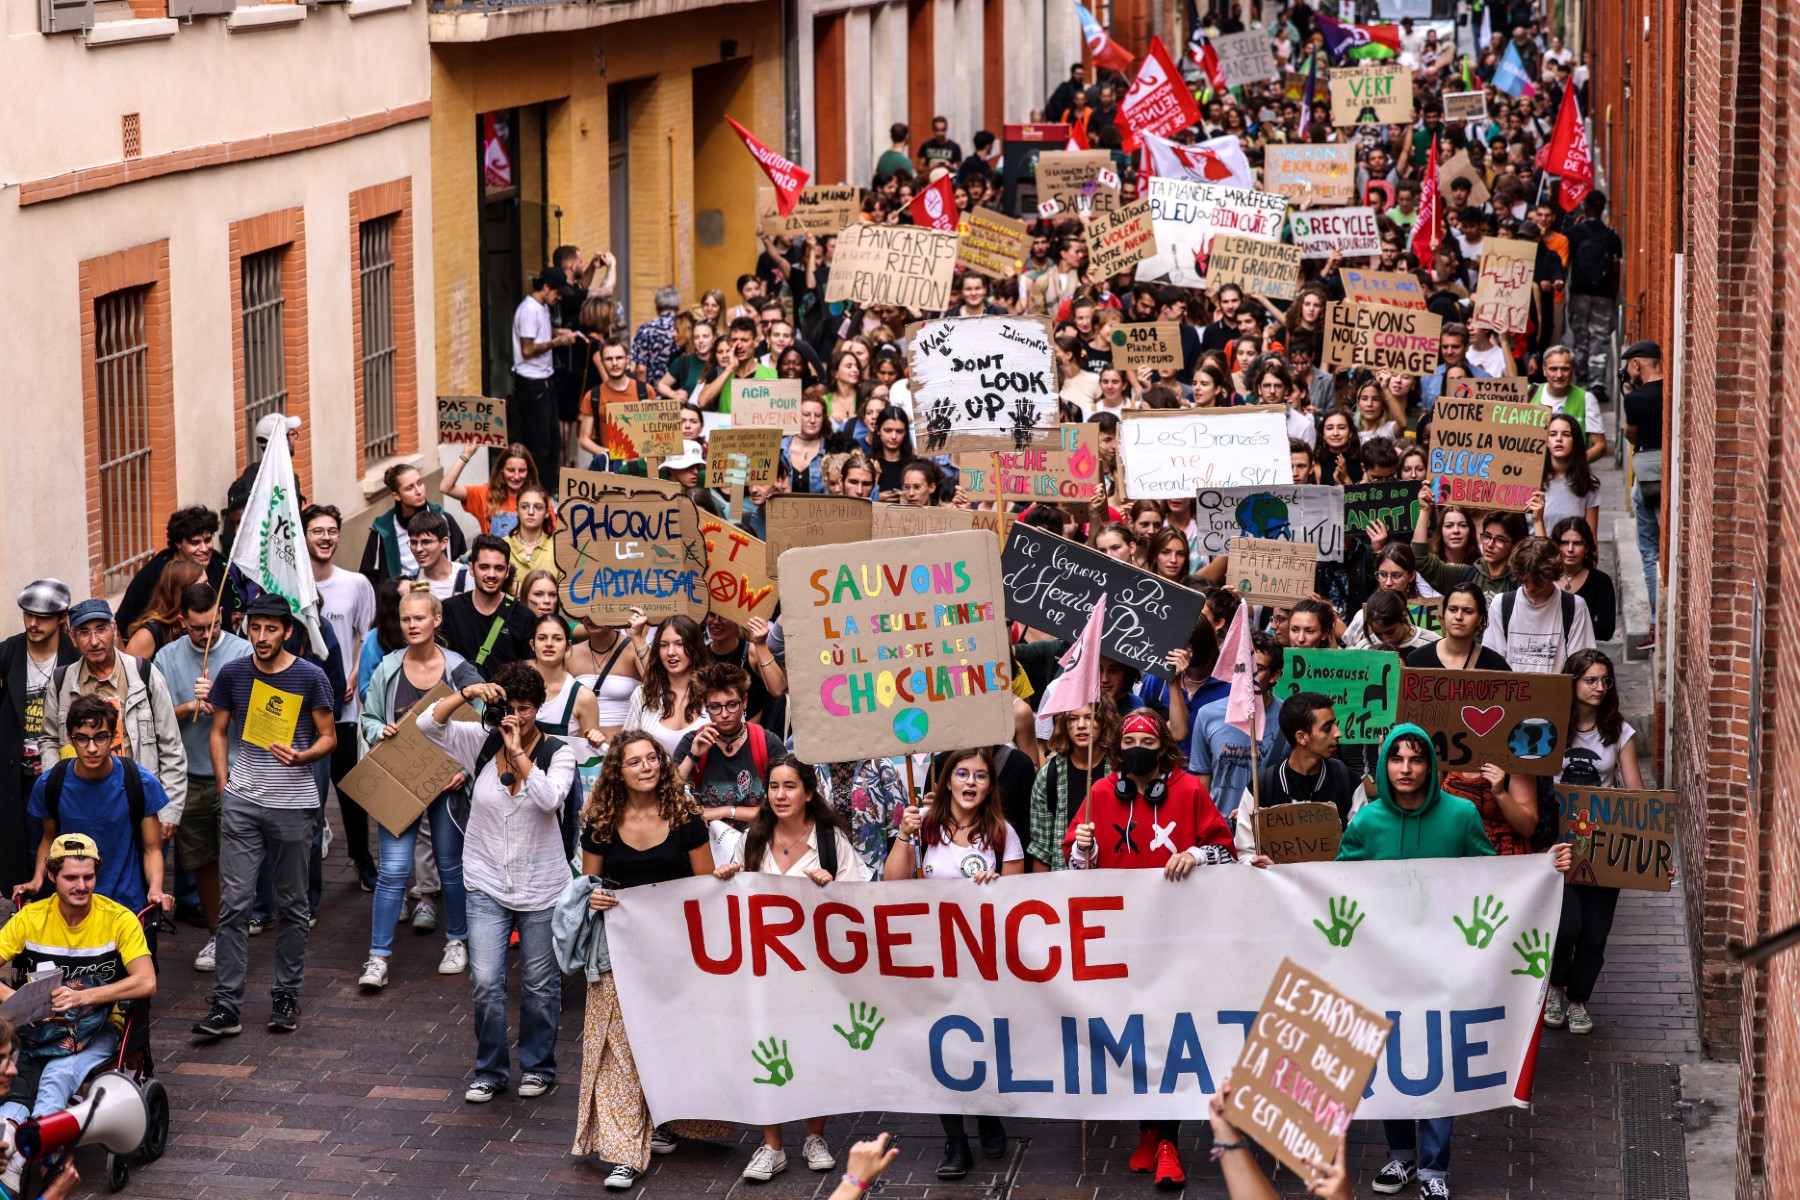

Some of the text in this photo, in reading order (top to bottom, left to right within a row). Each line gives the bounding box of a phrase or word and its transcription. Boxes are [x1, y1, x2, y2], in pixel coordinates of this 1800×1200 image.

[1349, 76, 1395, 98] VERT
[1150, 181, 1166, 196] TA
[1150, 198, 1197, 224] BLEU
[1211, 208, 1239, 229] BIEN
[1310, 215, 1376, 236] RECYCLE
[857, 225, 955, 259] PANCARTES
[1088, 222, 1107, 239] LES
[1091, 229, 1154, 268] NOTRE AVENIR
[1224, 237, 1300, 264] L'ENFUMAGE
[885, 252, 937, 276] RIEN
[1211, 253, 1301, 281] NUIT GRAVEMENT
[1332, 304, 1416, 333] ÉLEVONS
[1126, 341, 1167, 353] Planet B
[1129, 327, 1158, 342] 404
[1331, 328, 1440, 353] NOUS CONTRE
[951, 353, 1004, 372] DONT
[1127, 354, 1174, 364] NOT FOUND
[980, 371, 1048, 395] LOOK
[1476, 381, 1518, 393] TOTAL
[438, 400, 494, 415] PAS DE
[623, 401, 679, 413] NOUS SOMMES LES
[769, 398, 797, 410] POUR
[964, 393, 1005, 422] UP
[1437, 401, 1484, 422] VOTRE
[439, 420, 490, 432] PAS DE
[440, 412, 490, 423] CLIMAT
[1060, 427, 1079, 451] TE
[1134, 422, 1271, 449] Les Bronzés
[1436, 430, 1546, 455] VOUS LA VOULEZ
[711, 459, 729, 470] RES
[1171, 454, 1201, 469] ne
[1431, 447, 1495, 479] BLEUE
[1502, 464, 1523, 477] OU
[711, 470, 769, 484] SA BLE
[961, 468, 987, 492] JE
[1033, 475, 1058, 497] LES
[1133, 466, 1191, 492] Feront
[1452, 477, 1497, 503] BIEN
[1369, 487, 1409, 500] is no
[769, 501, 863, 520] LES DAUPHINS
[570, 502, 683, 549] PHOQUE
[806, 521, 825, 536] PAS
[270, 534, 283, 547] FOR
[615, 541, 644, 561] LE
[1239, 551, 1315, 573] PATRIARCAT
[569, 566, 703, 605] CAPITALISME
[809, 560, 971, 607] SAUVONS
[1013, 533, 1041, 559] ne
[1114, 577, 1172, 621] Pas
[1259, 573, 1310, 595] PLANETE
[590, 602, 616, 614] ET LE
[823, 600, 995, 639] LA SEULE PLANETE
[1046, 604, 1172, 672] en Plastique
[819, 637, 978, 667] OÙ IL EXISTE LES
[1292, 654, 1370, 682] Dinosaussi
[1403, 673, 1532, 702] RECHAUFFE
[1344, 710, 1356, 740] le
[1404, 702, 1450, 729] MON
[1430, 731, 1473, 767] AS
[356, 734, 421, 796] QUI NE
[396, 745, 439, 788] RESIST
[1590, 795, 1676, 834] NATURE
[1590, 831, 1672, 879] FUTUR
[683, 893, 1128, 983] URGENCE
[1273, 971, 1310, 1013] LE
[1241, 1041, 1270, 1080] LA
[1258, 1012, 1356, 1092] C'EST BIEN
[1233, 1085, 1283, 1133] C'EST
